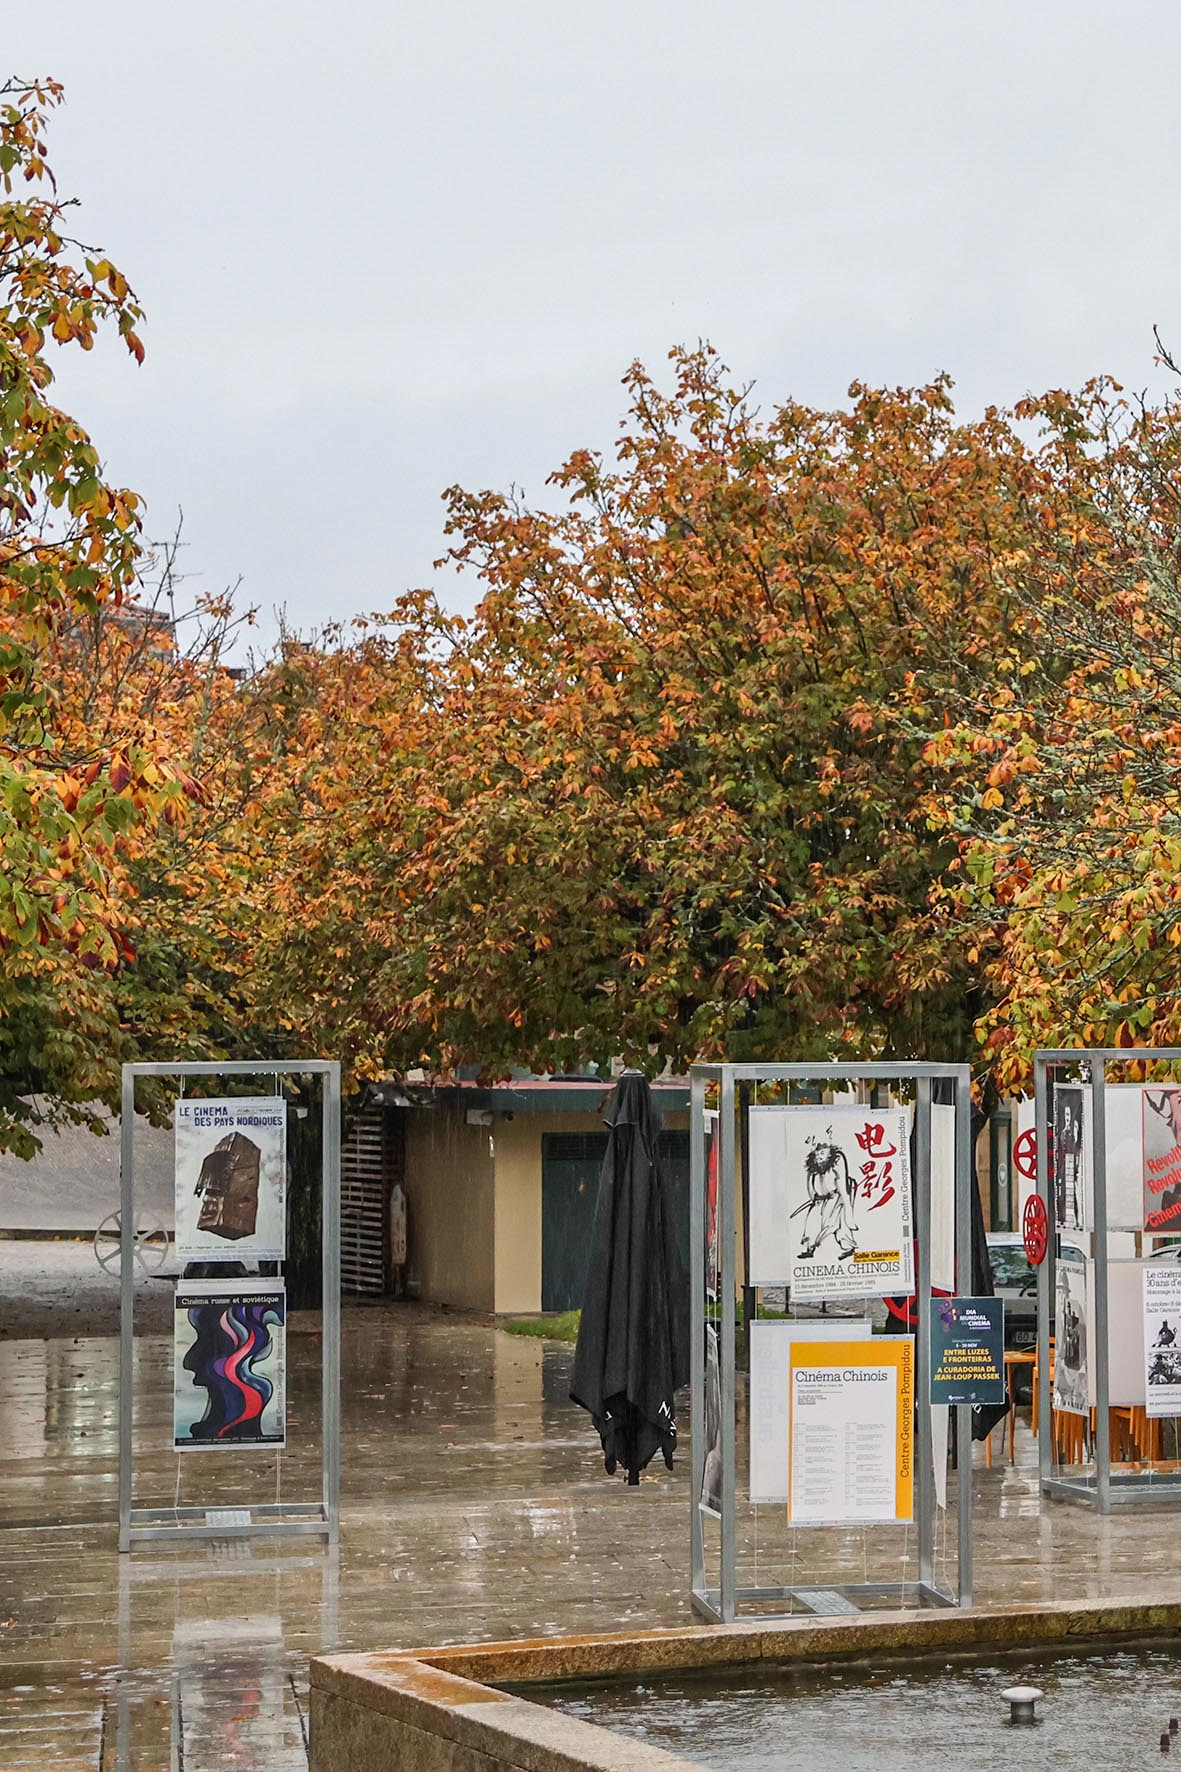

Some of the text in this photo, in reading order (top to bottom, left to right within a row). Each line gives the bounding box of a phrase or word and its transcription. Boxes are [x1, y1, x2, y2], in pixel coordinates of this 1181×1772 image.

[180, 1107, 190, 1116] LE
[194, 1106, 228, 1116] CINEMA
[194, 1116, 283, 1126] DES PAYS NORDIQUES
[852, 1122, 897, 1212] 电影
[899, 1115, 910, 1222] Centre Georges Pompidou
[793, 1264, 844, 1278] CINEMA
[847, 1262, 901, 1275] CHINOIS
[1146, 1270, 1156, 1278] Le
[1147, 1279, 1155, 1287] 30
[181, 1297, 209, 1305] Cinéma
[242, 1295, 279, 1304] soviétique
[795, 1370, 888, 1382] Cinéma Chinois
[900, 1344, 912, 1478] Centre Georges Pompidou
